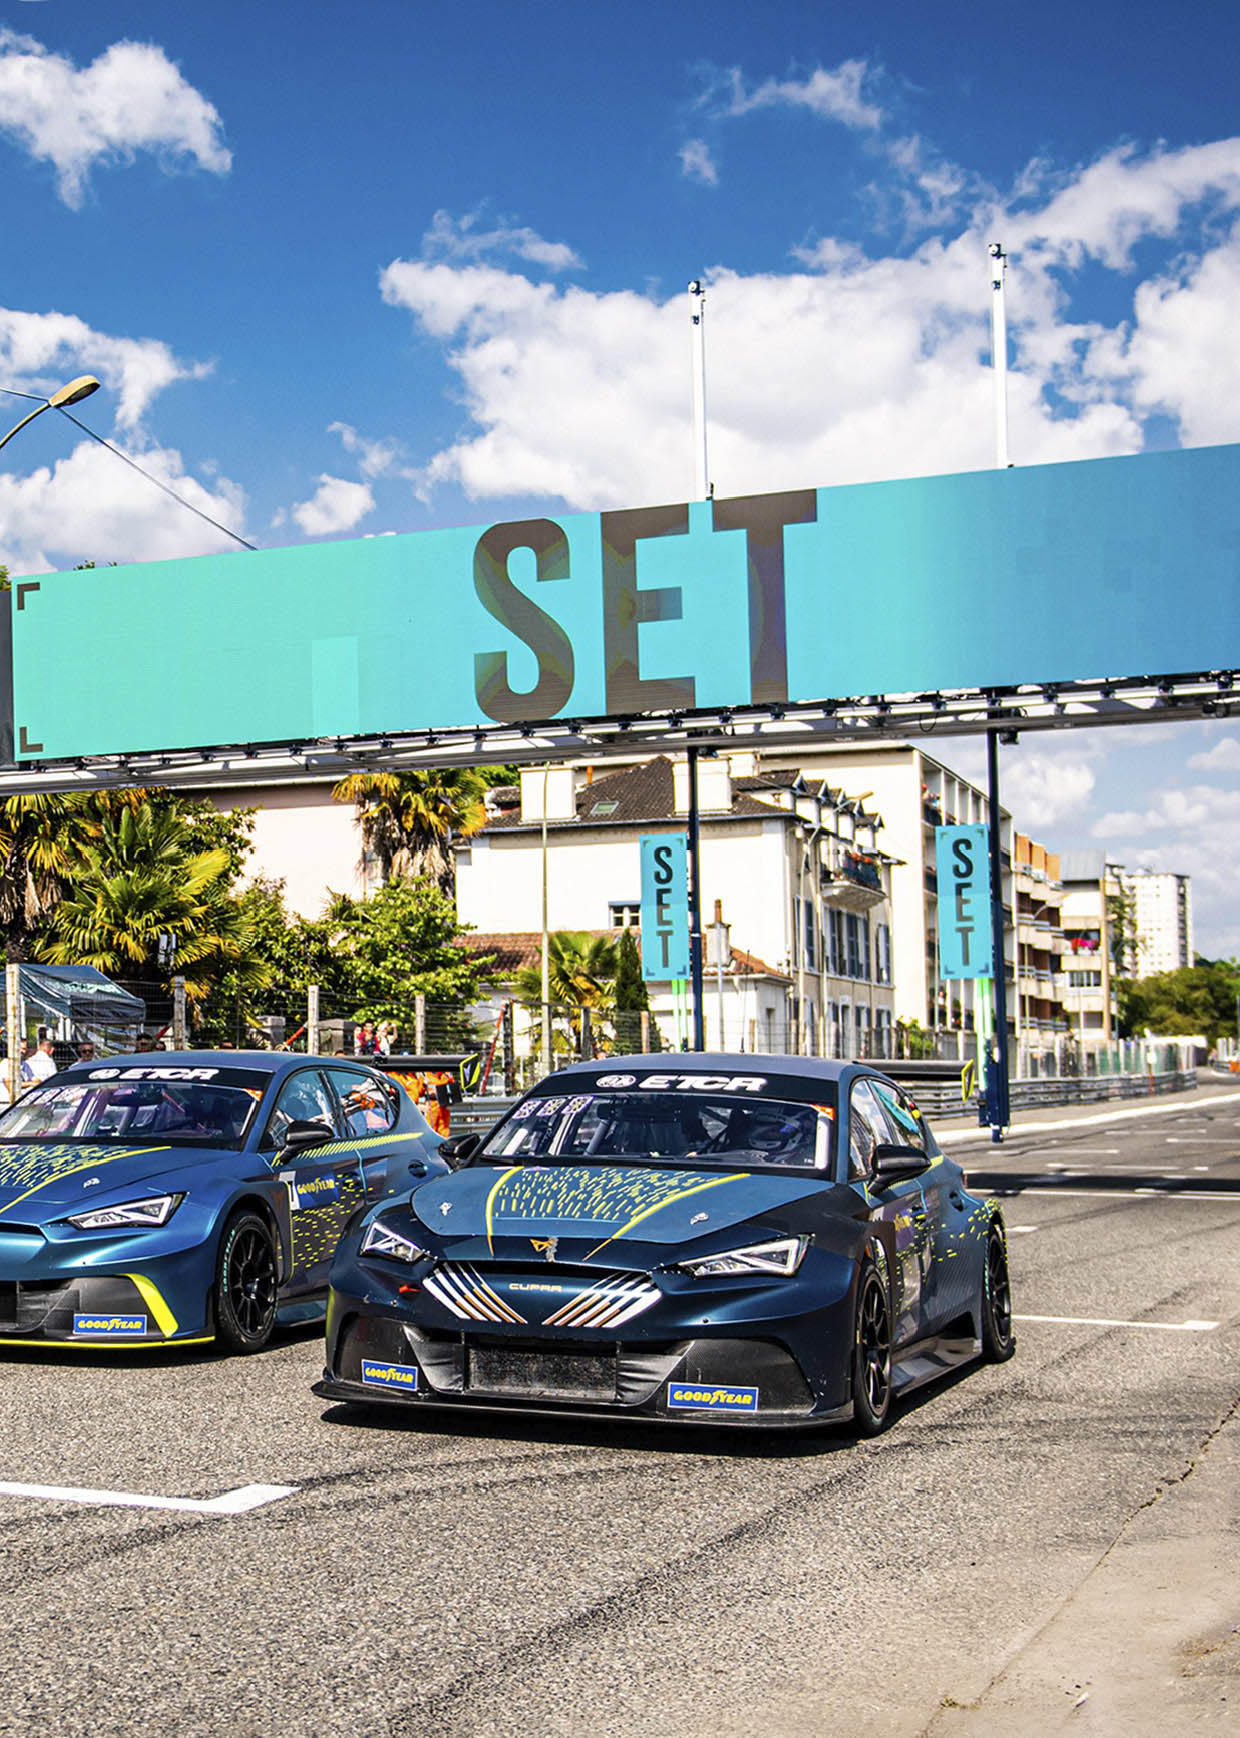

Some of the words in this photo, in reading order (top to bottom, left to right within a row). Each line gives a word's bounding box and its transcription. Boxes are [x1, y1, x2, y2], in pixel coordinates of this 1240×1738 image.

[473, 488, 818, 723] SET
[653, 845, 674, 969] SET
[952, 838, 975, 967] SET
[118, 1067, 220, 1080] ETCR
[638, 1074, 768, 1092] ETCR
[509, 1283, 562, 1292] CUPRA
[77, 1317, 143, 1331] GOODYEAR
[365, 1367, 414, 1383] GOODYEAR
[673, 1390, 753, 1405] GOODYEAR
